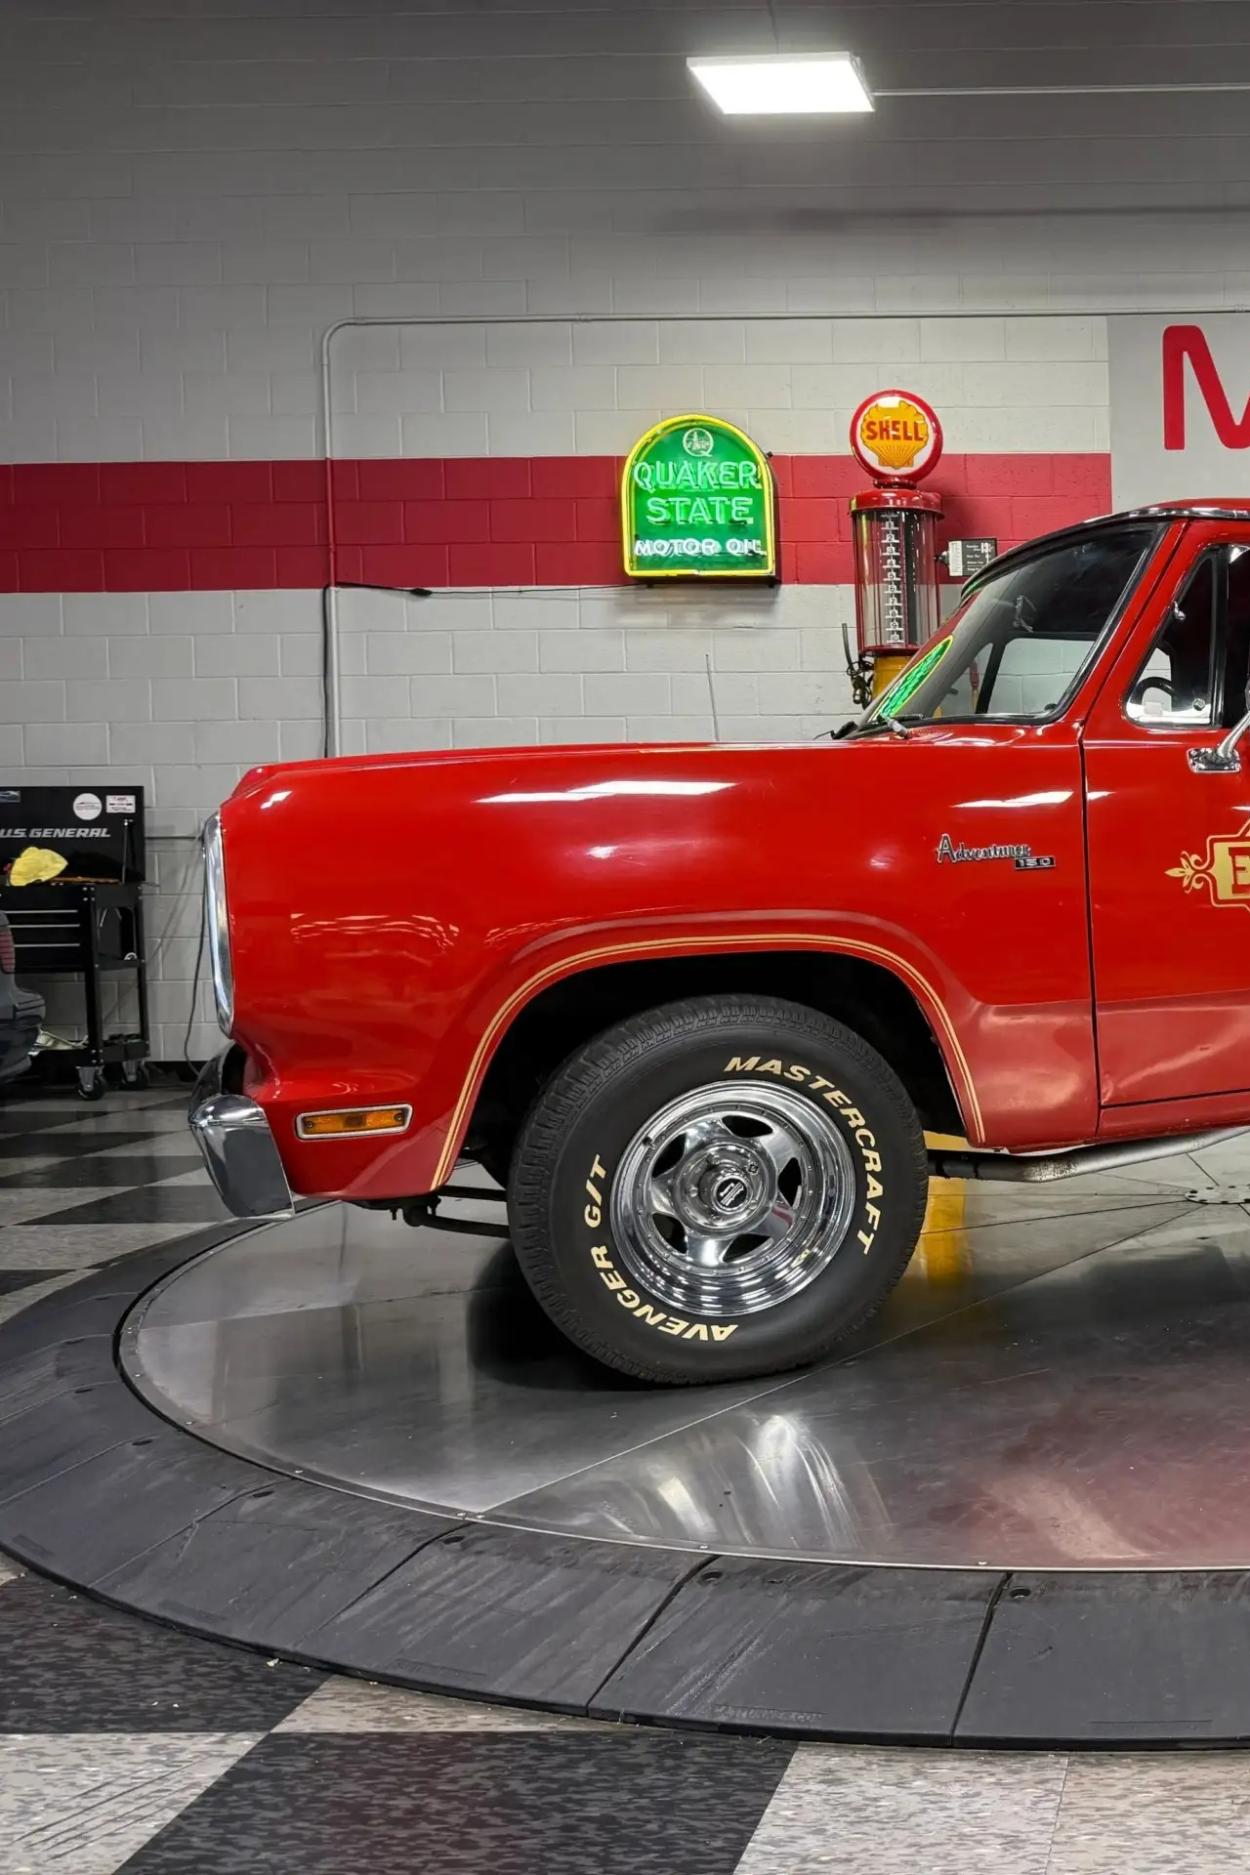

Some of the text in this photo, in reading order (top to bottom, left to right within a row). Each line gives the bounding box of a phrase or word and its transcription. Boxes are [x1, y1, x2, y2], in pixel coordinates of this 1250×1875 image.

[864, 419, 925, 442] SHELL
[633, 459, 763, 493] QUAKER
[646, 496, 755, 526] STATE
[633, 537, 722, 557] MOTOR
[29, 828, 111, 838] GENERAL
[723, 1056, 884, 1255] MASTERCRAFT
[583, 1153, 739, 1342] AVENGER G/T
